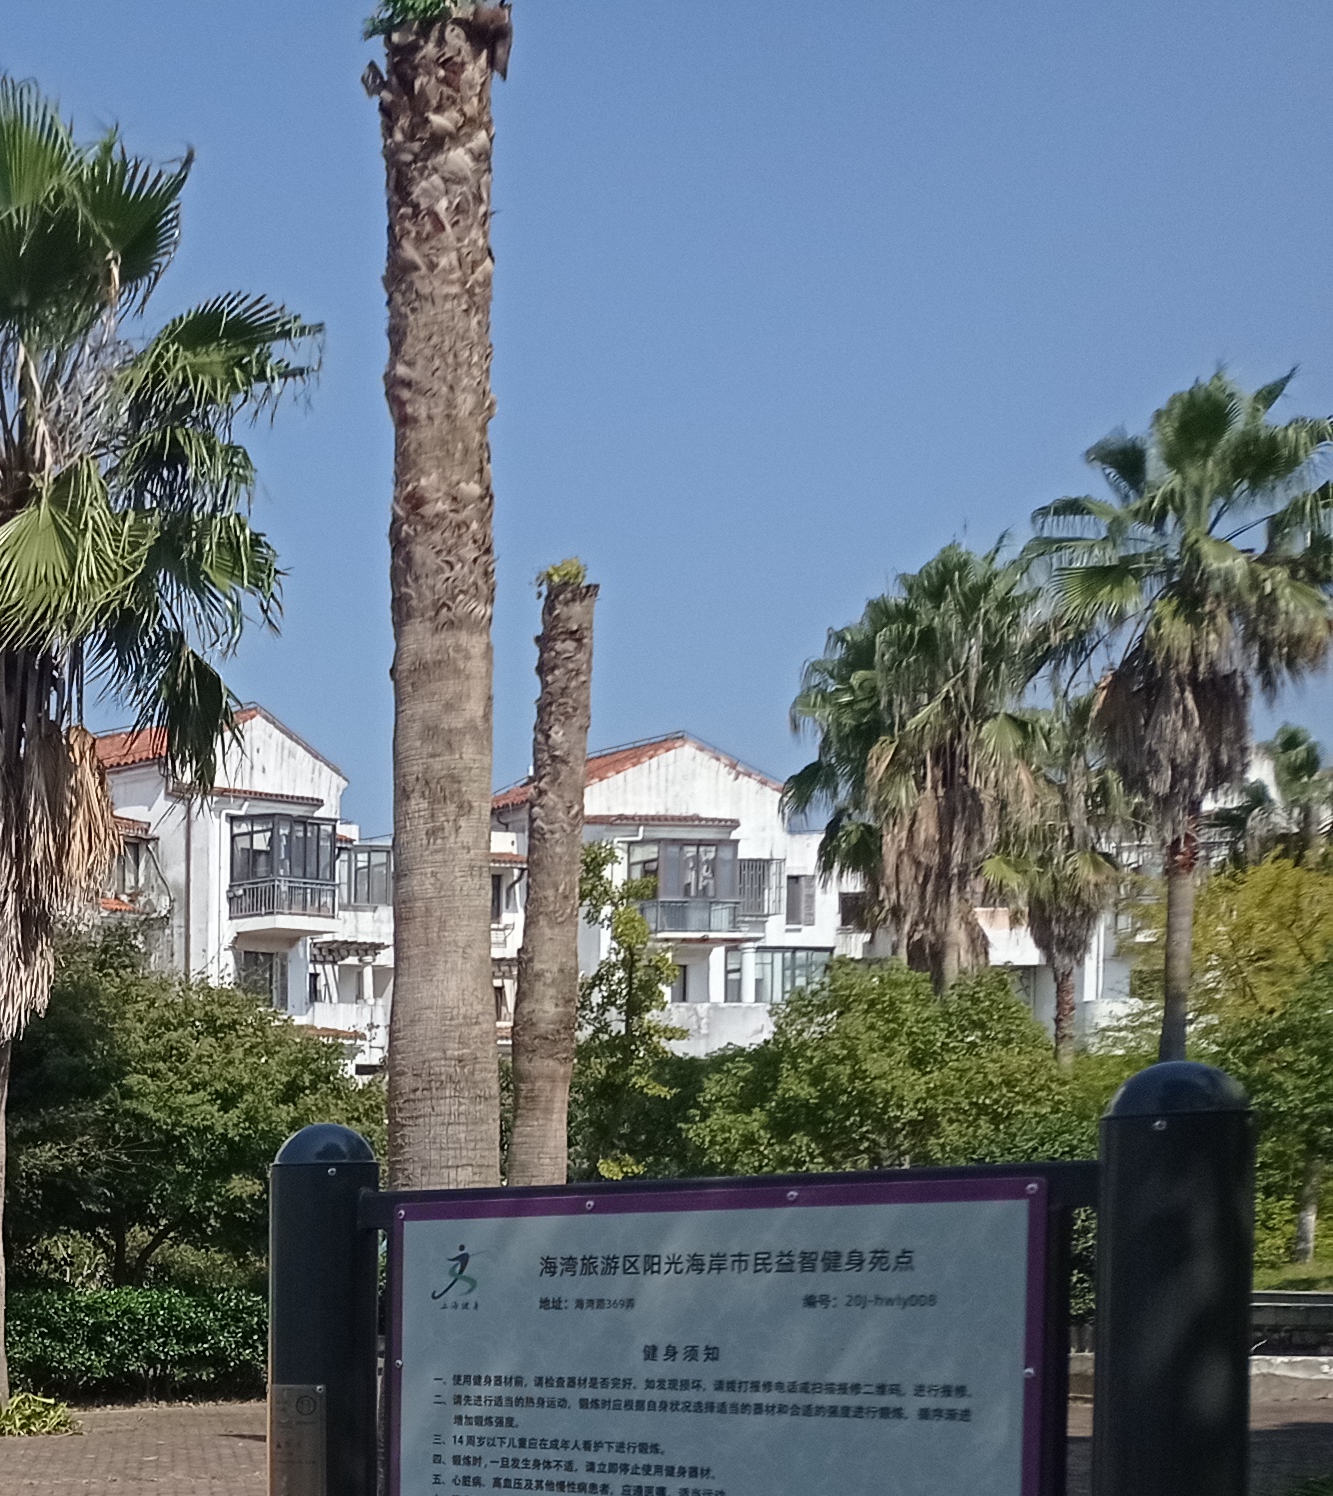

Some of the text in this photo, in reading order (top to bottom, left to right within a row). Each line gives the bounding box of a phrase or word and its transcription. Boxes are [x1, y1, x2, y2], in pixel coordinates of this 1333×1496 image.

[538, 1249, 915, 1278] 海湾旅游区阳光海岸市民益智健身苑点
[642, 1344, 721, 1363] 健身须知
[453, 1414, 520, 1429] 增加锻炼强度。
